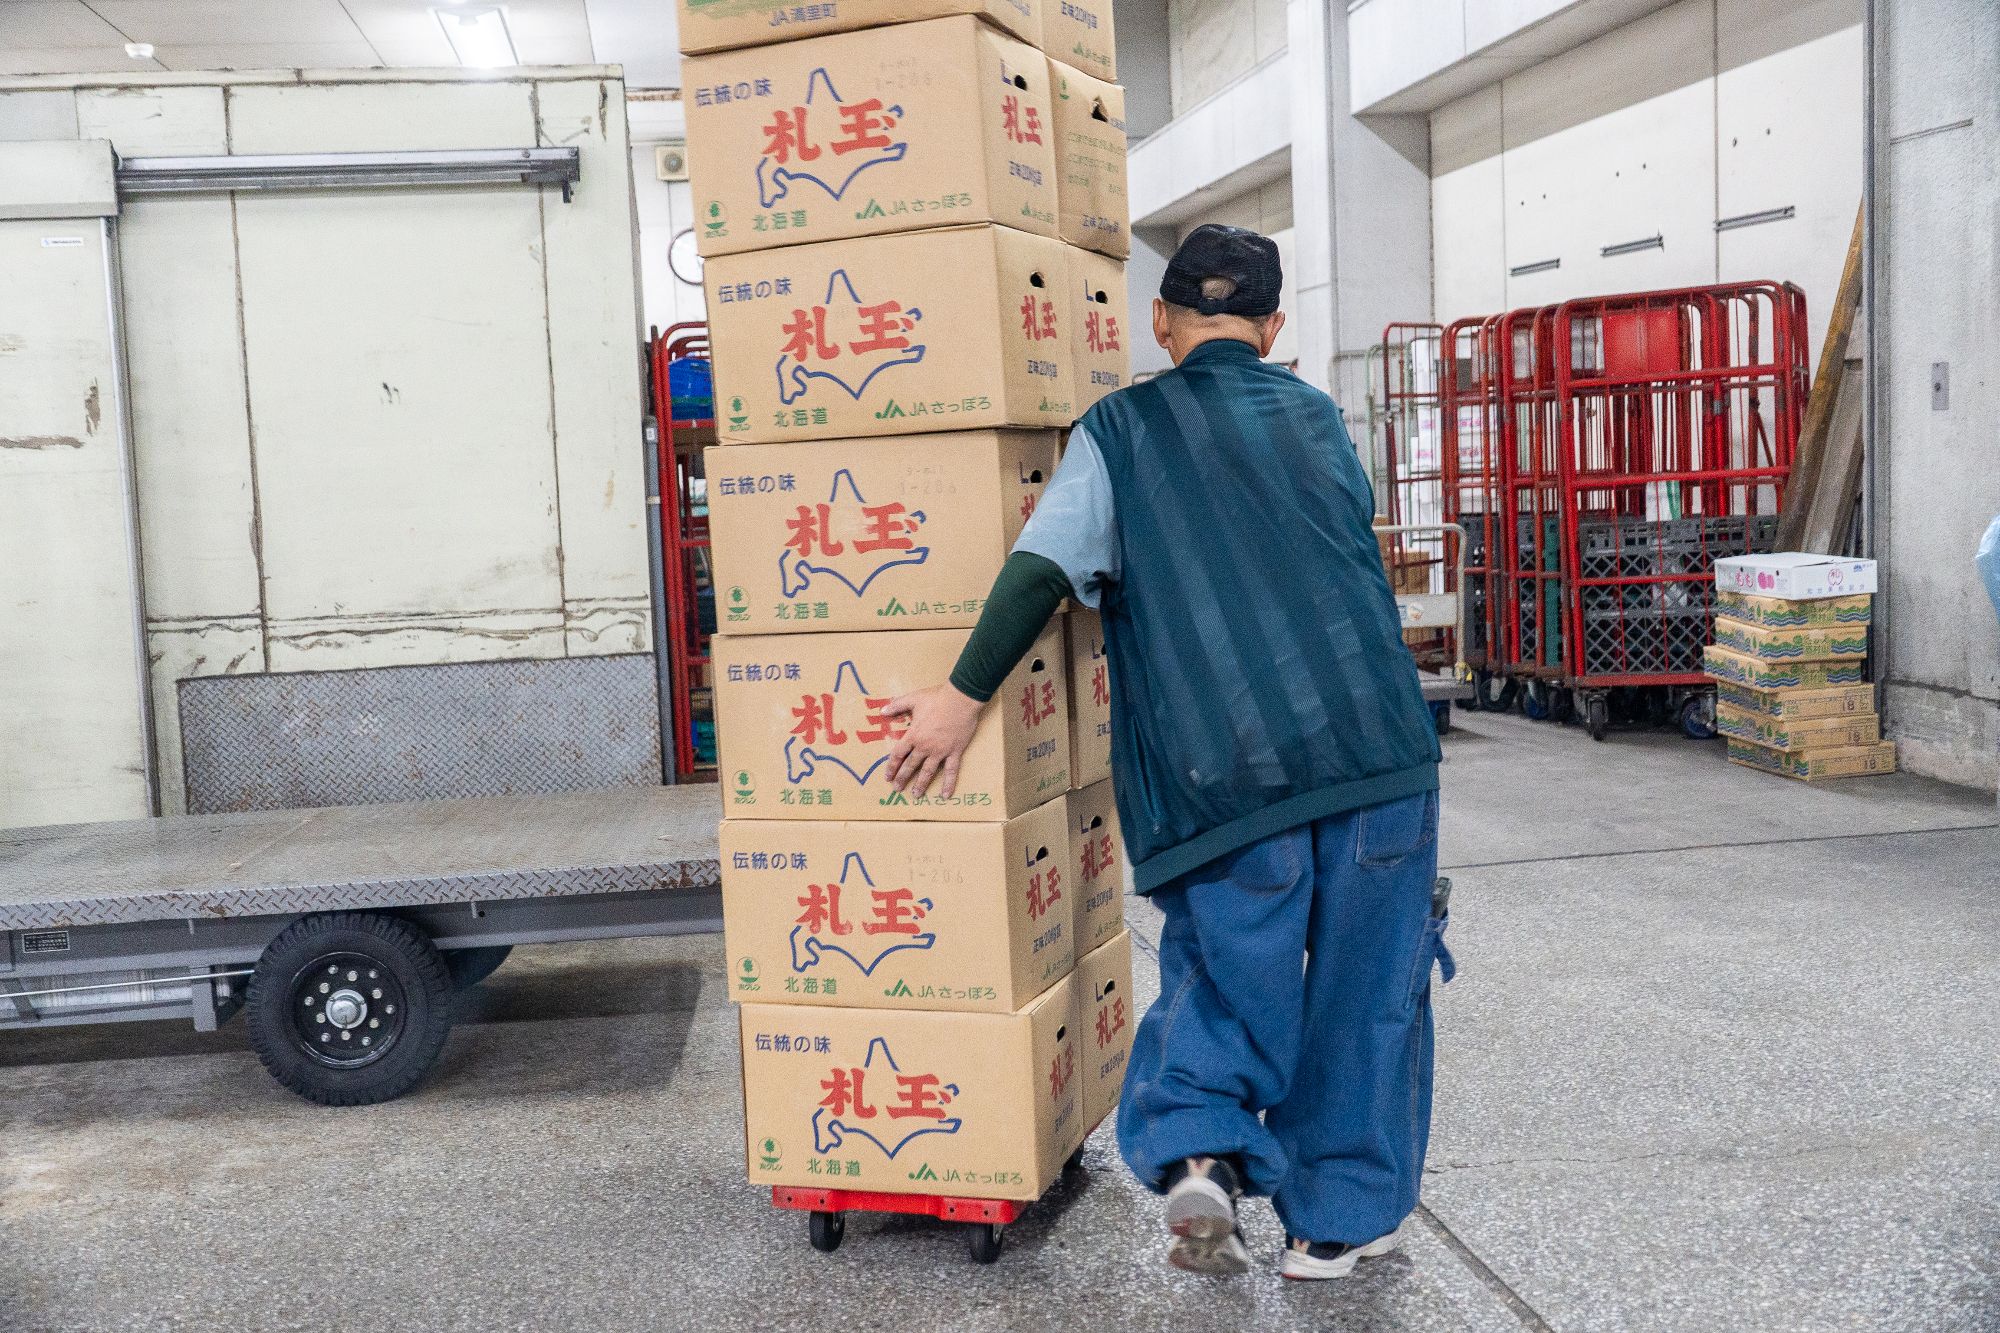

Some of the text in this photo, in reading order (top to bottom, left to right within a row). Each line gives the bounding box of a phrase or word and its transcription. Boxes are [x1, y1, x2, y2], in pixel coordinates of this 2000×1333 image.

[694, 78, 773, 107] 伝統の味
[762, 98, 896, 164] 札玉
[1002, 95, 1042, 146] 札玉
[752, 209, 808, 232] 北海道
[718, 277, 792, 304] 伝統の味
[781, 300, 914, 363] 札玉
[1020, 295, 1057, 342] 札玉
[1085, 311, 1120, 354] 札玉
[773, 407, 829, 428] 北海道
[909, 396, 992, 417] JAさっぽろ
[719, 473, 797, 497] 伝統の味
[785, 502, 919, 557] 札玉
[775, 601, 830, 621] 北海道
[727, 663, 801, 682] 伝統の味
[1020, 680, 1056, 730] 札玉
[780, 788, 833, 806] 北海道
[732, 851, 808, 871] 伝統の味
[1080, 833, 1114, 883] 札玉
[1026, 865, 1062, 922] 札玉
[796, 883, 926, 936] 札玉
[784, 976, 838, 997] 北海道
[918, 986, 997, 1001] JAさっぽろ
[1096, 996, 1126, 1051] 札玉
[755, 1033, 832, 1054] 伝統の味
[819, 1067, 952, 1120] 札玉
[806, 1157, 862, 1178] 北海道
[942, 1168, 1024, 1185] JAさっぽろ
